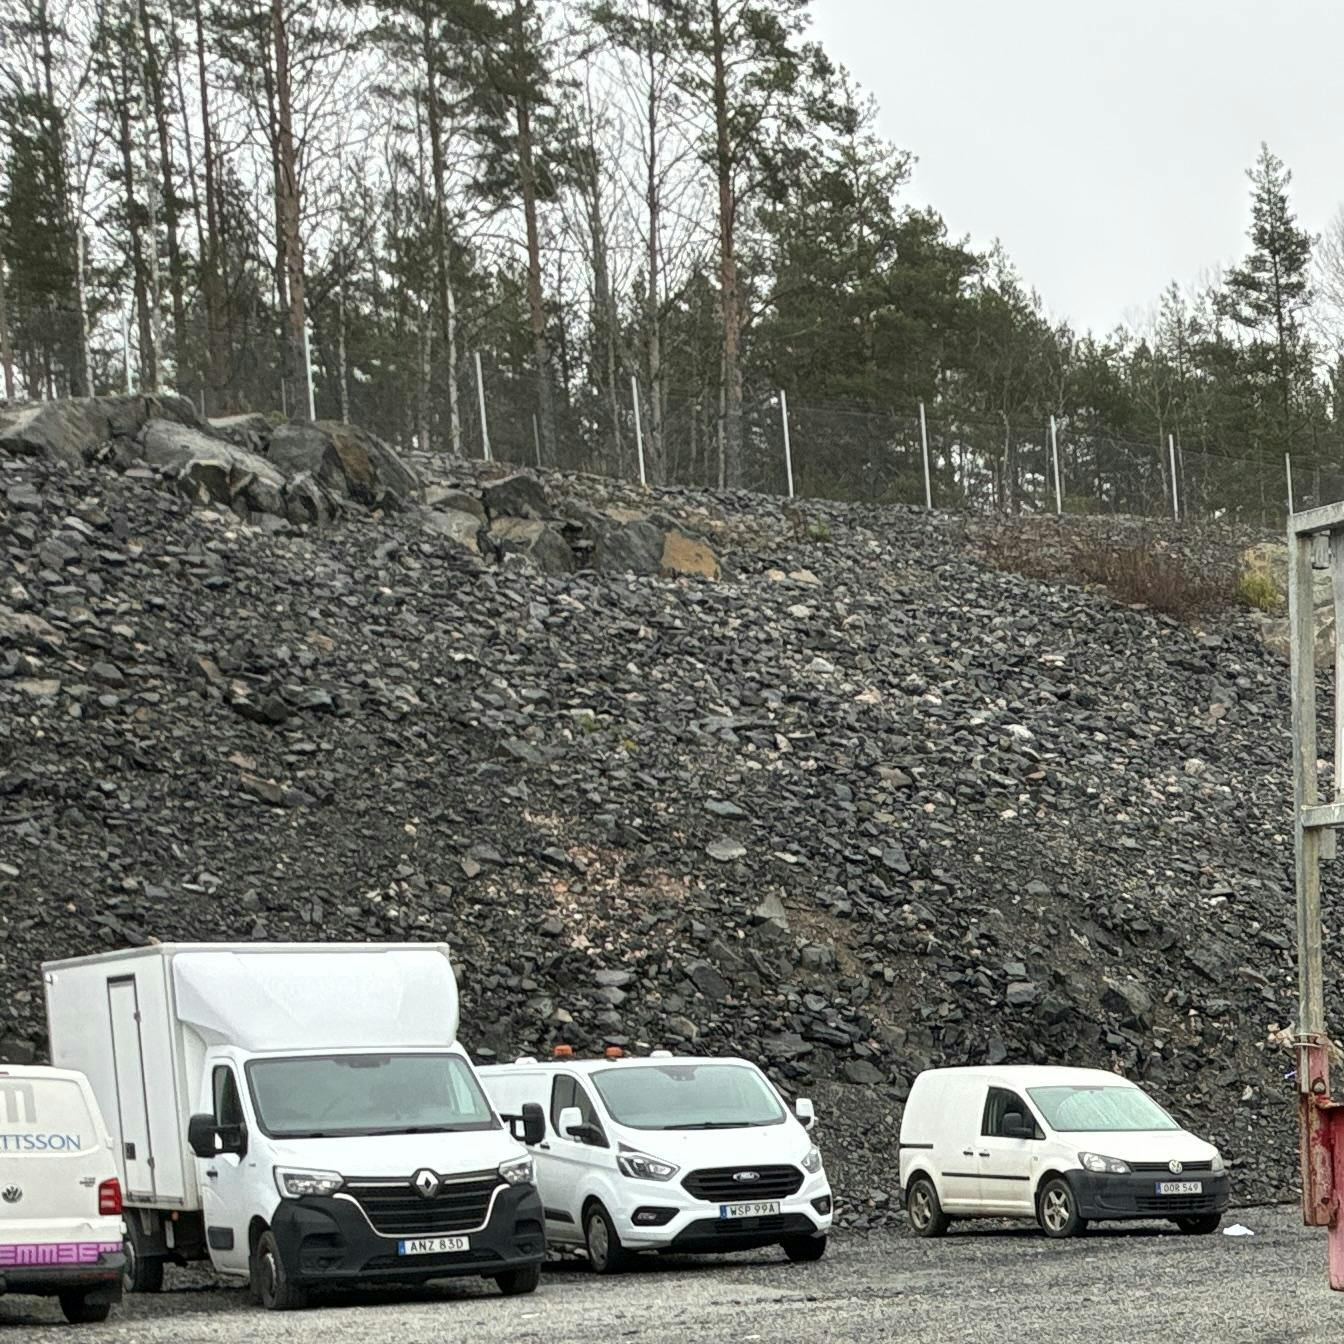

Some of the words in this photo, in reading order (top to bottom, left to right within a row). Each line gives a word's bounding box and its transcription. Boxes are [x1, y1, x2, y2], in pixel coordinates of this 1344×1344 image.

[0, 1133, 81, 1150] TTSSON
[730, 1204, 751, 1216] WSP
[410, 1240, 435, 1252] ANZ
[440, 1238, 464, 1250] 83D
